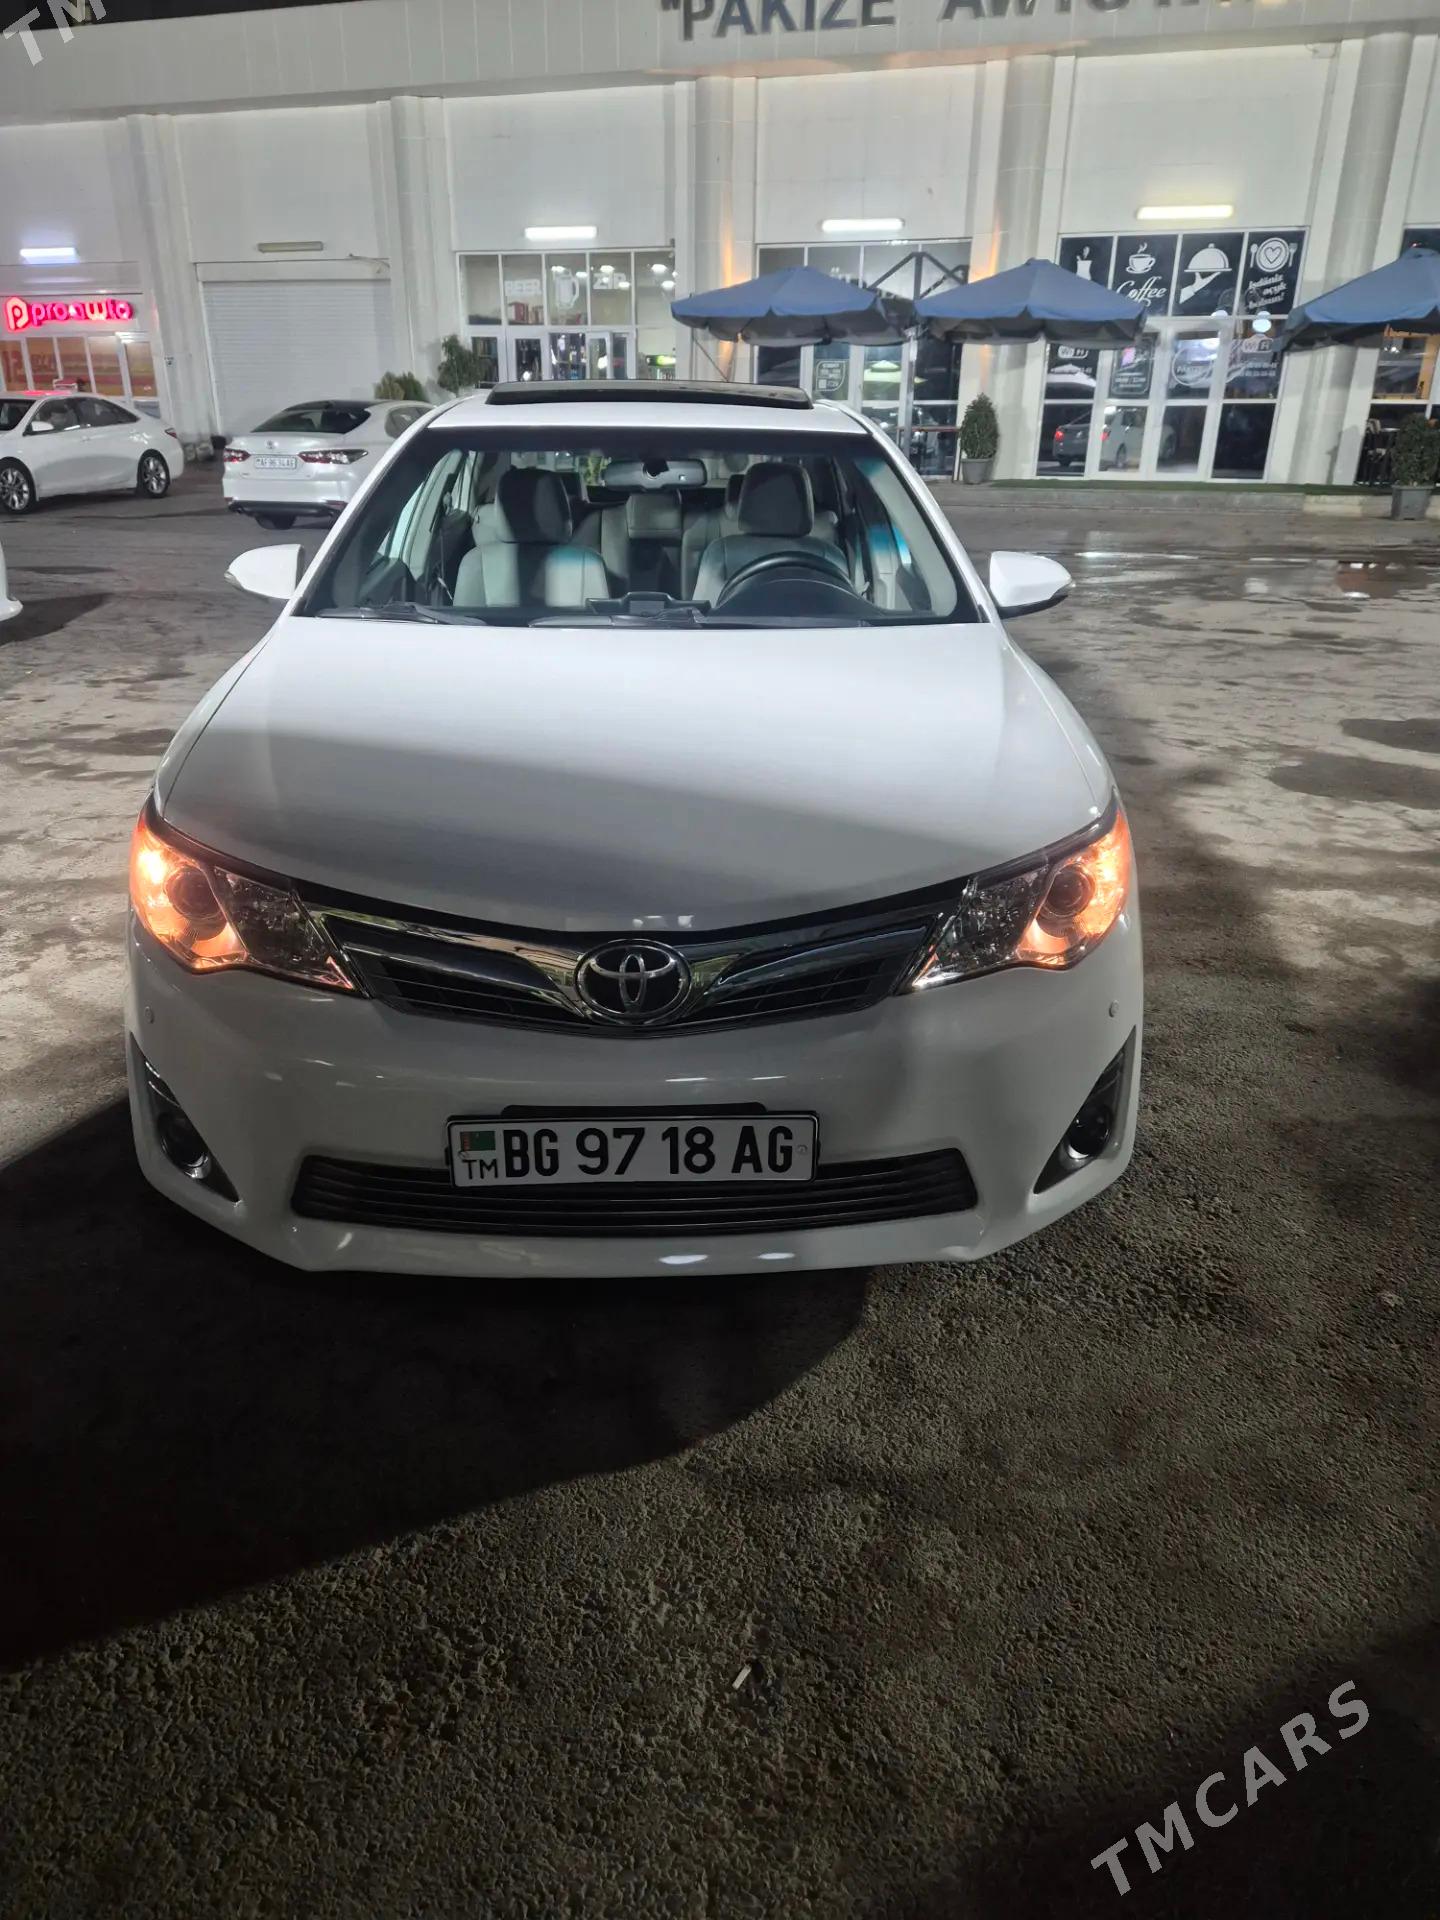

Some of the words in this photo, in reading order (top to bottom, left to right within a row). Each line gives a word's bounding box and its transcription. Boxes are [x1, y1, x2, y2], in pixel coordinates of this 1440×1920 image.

[1116, 275, 1168, 307] Coffee
[503, 1128, 559, 1178] BG
[576, 1127, 645, 1175] 97
[661, 1126, 716, 1175] 18
[731, 1125, 793, 1174] AG
[462, 1158, 499, 1180] TM
